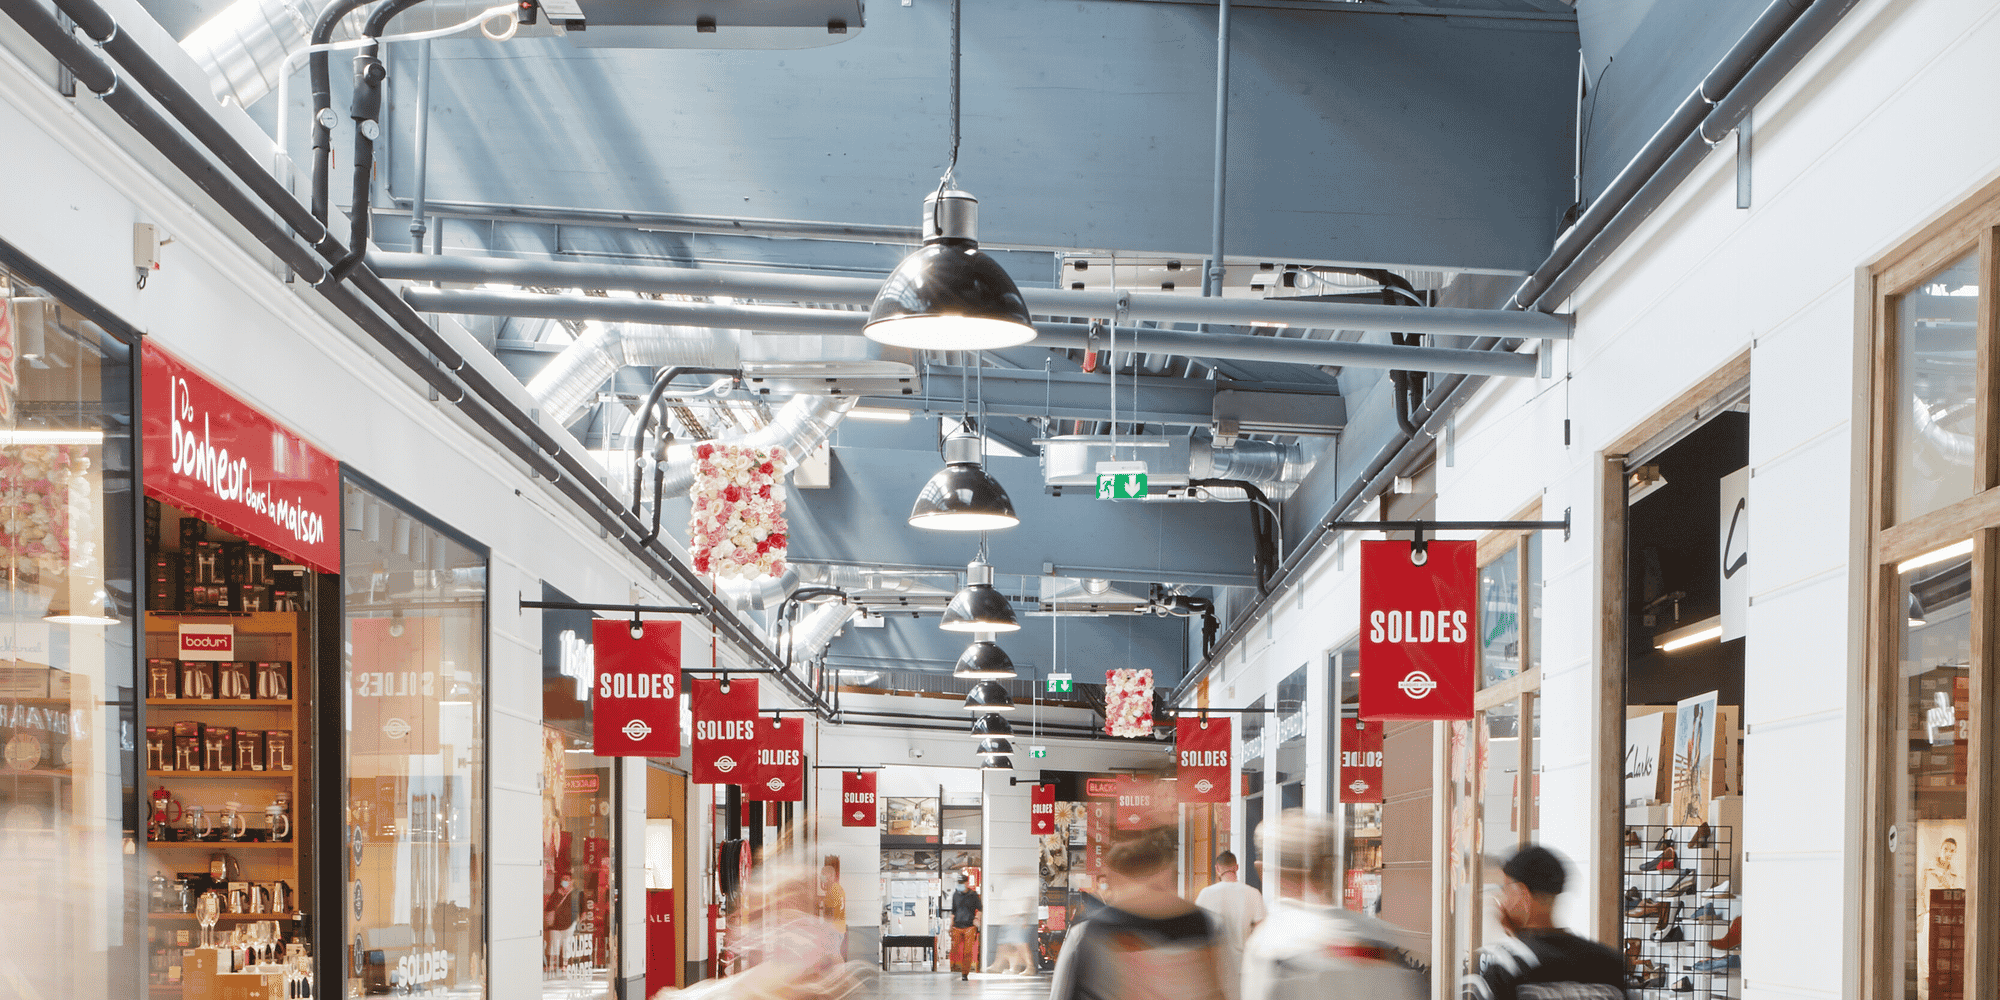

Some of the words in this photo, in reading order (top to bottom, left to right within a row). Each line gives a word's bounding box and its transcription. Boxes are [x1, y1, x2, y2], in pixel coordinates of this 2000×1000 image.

[172, 375, 247, 503] bonheur
[246, 468, 267, 514] dans
[268, 482, 276, 523] la
[1370, 610, 1467, 643] SOLDES
[185, 636, 227, 648] bodum
[600, 673, 674, 699] SOLDES
[697, 720, 754, 740] SOLDES
[1181, 750, 1227, 767] SOLDES
[844, 792, 875, 804] SOLDES
[1119, 795, 1150, 807] SOLDES
[1032, 803, 1053, 814] SOLDES
[567, 934, 593, 959] SOLDES
[399, 950, 448, 987] SOLDES
